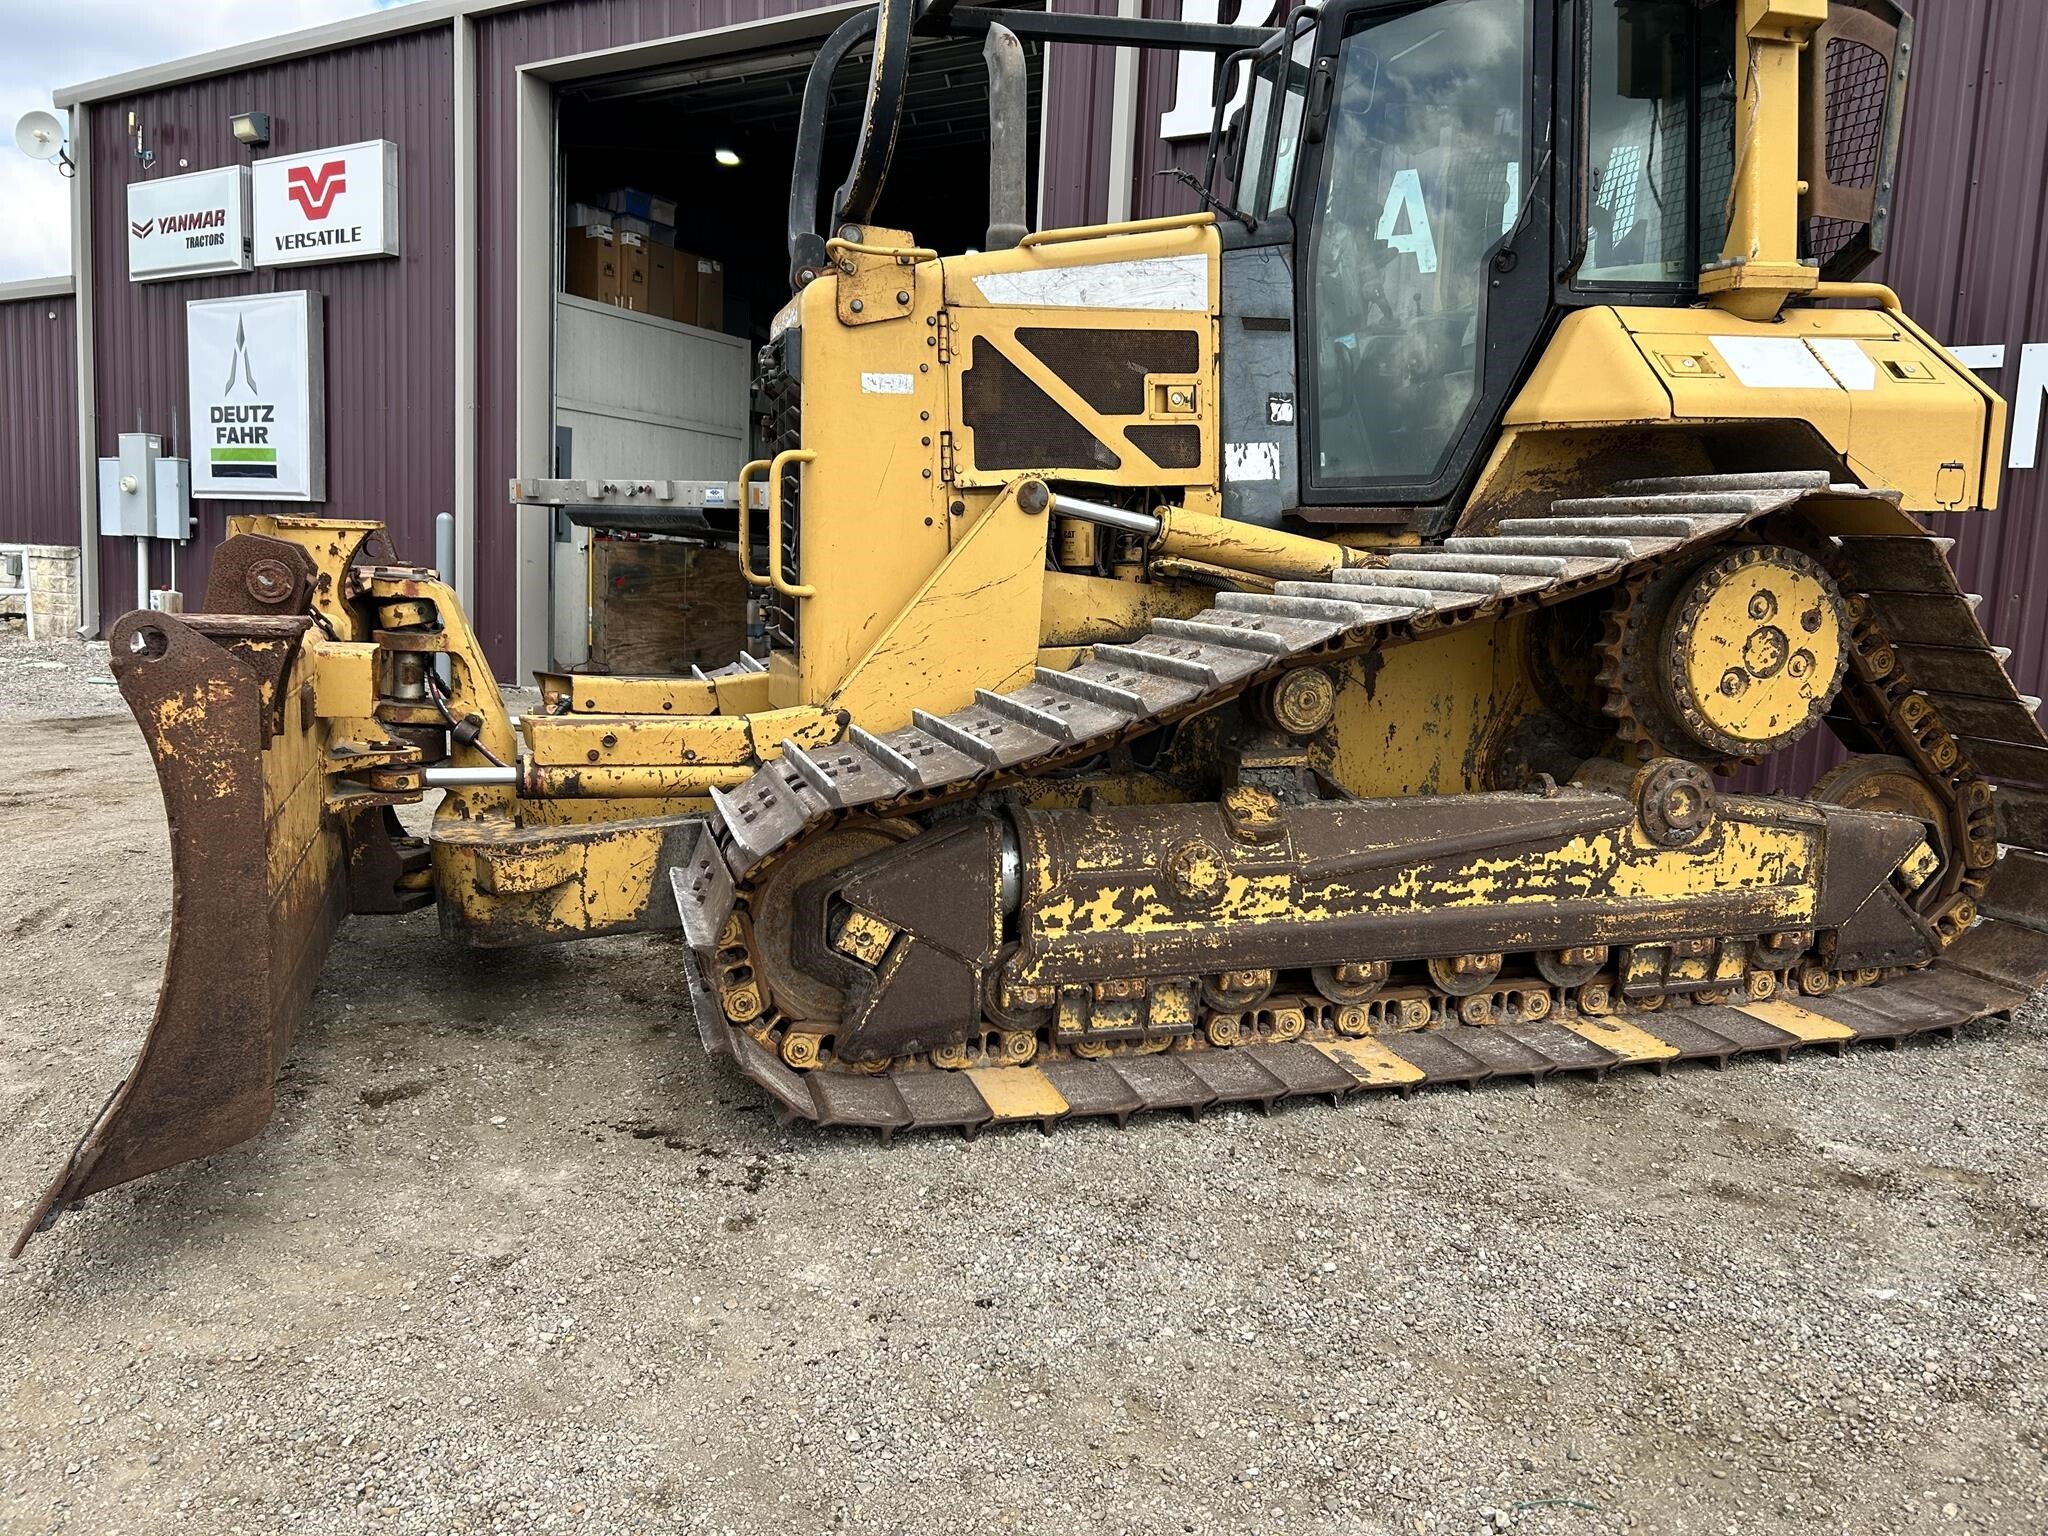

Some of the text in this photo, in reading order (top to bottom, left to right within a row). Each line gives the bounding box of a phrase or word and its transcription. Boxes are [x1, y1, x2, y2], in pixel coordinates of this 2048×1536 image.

[158, 209, 225, 234] YANMAR
[186, 233, 224, 249] TRACTORS
[275, 226, 361, 250] VERSATILE
[210, 405, 274, 423] DEUTZ
[216, 427, 268, 444] FAHR
